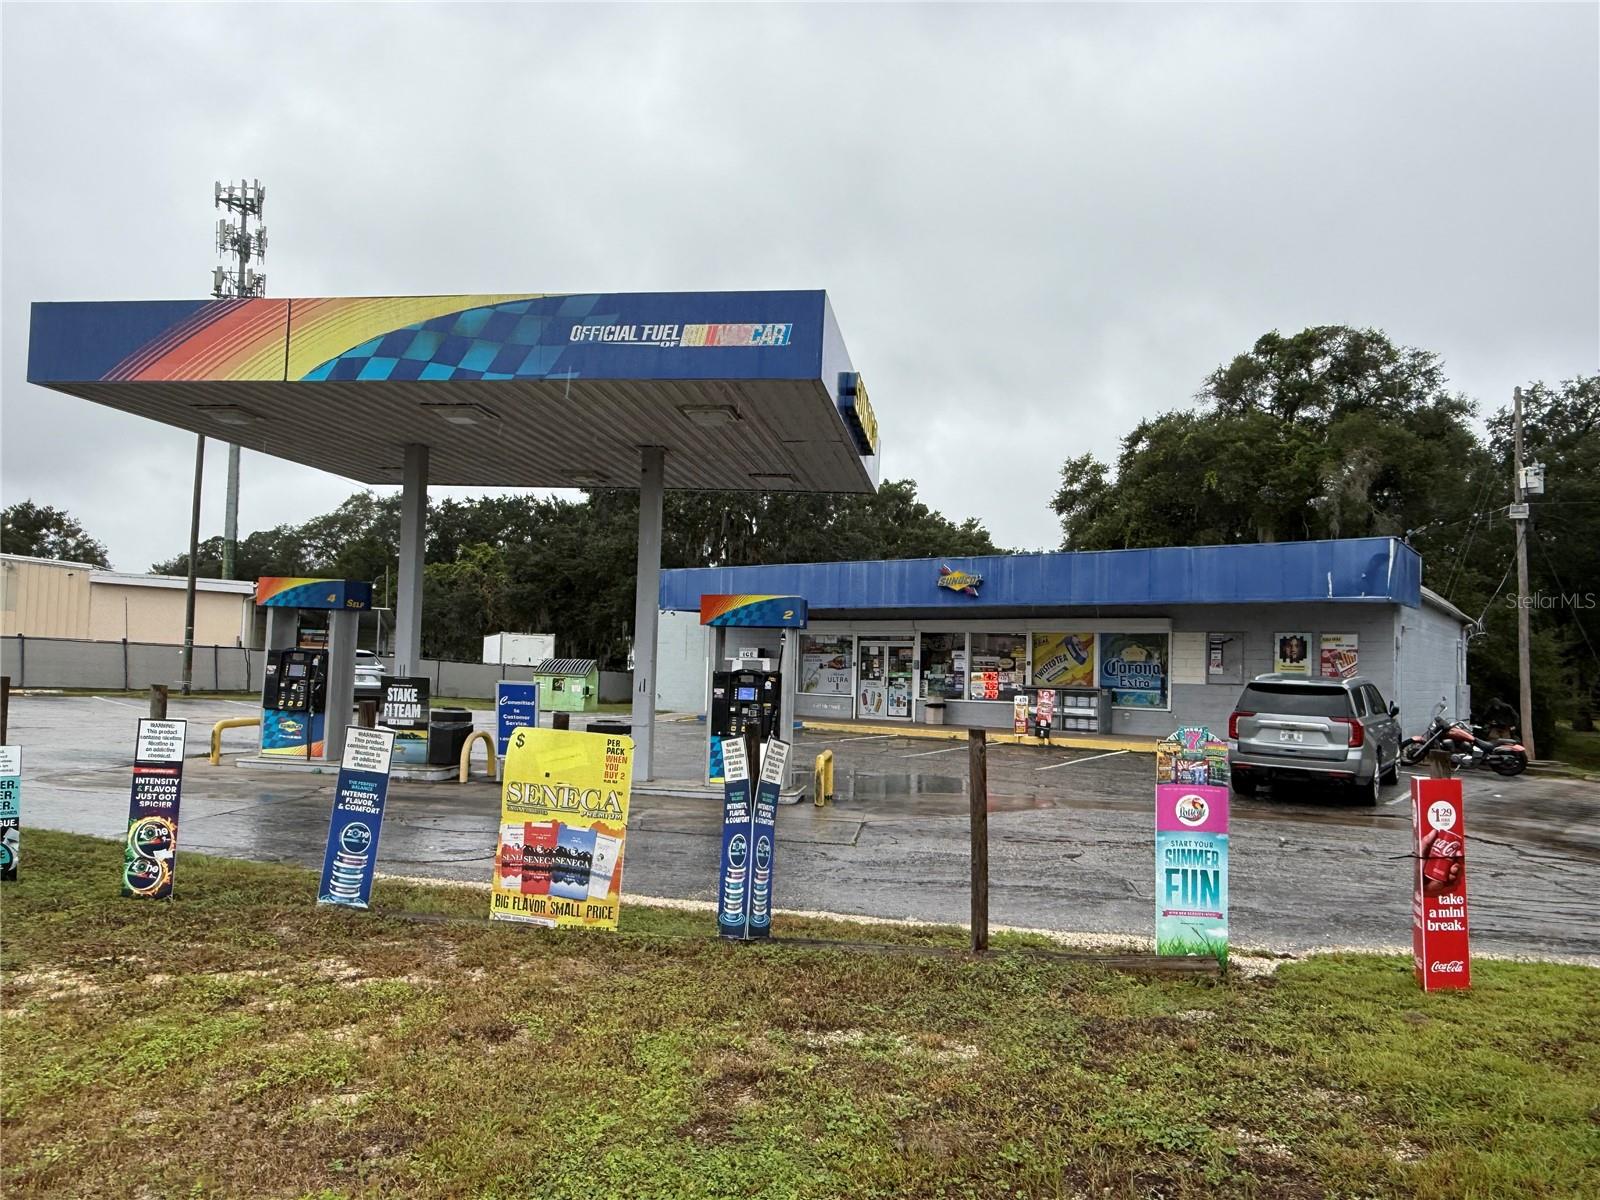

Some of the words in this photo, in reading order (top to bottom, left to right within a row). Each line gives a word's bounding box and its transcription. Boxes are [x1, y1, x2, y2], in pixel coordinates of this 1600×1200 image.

[569, 325, 638, 341] OFFICIAL
[641, 325, 680, 340] FUEL
[938, 574, 978, 587] SUNOCO
[327, 594, 336, 602] 4
[783, 610, 794, 619] 2
[1035, 658, 1057, 679] TWISTED
[1103, 658, 1161, 678] Corona
[1120, 676, 1150, 688] Extra
[388, 688, 418, 702] STAKE
[500, 696, 535, 705] Committed
[384, 703, 393, 717] F1
[393, 704, 421, 718] TEAM
[515, 733, 526, 749] $
[607, 739, 621, 747] PER
[1185, 731, 1202, 750] 7
[606, 747, 625, 755] PACK
[605, 755, 628, 764] WHEN
[604, 763, 619, 771] YOU
[135, 777, 180, 785] INTENSITY
[604, 771, 618, 779] BUY
[341, 790, 379, 801] INTENSITY,
[506, 782, 623, 813] SENECA
[346, 798, 375, 807] FLAVOR,
[345, 805, 380, 814] COMFORT
[580, 811, 623, 820] PREMIUM
[523, 855, 556, 865] SENECA
[555, 856, 590, 868] SENECA
[1165, 849, 1219, 867] SUMMER
[1165, 868, 1220, 907] FUN
[1439, 893, 1464, 905] take
[495, 894, 509, 909] BIG
[512, 897, 546, 914] FLAVOR
[550, 902, 581, 917] SMALL
[586, 905, 614, 919] PRICE
[1429, 909, 1437, 918] a
[1439, 906, 1464, 918] mini
[1427, 920, 1465, 931] break.
[1431, 960, 1464, 972] Coca-Cola
